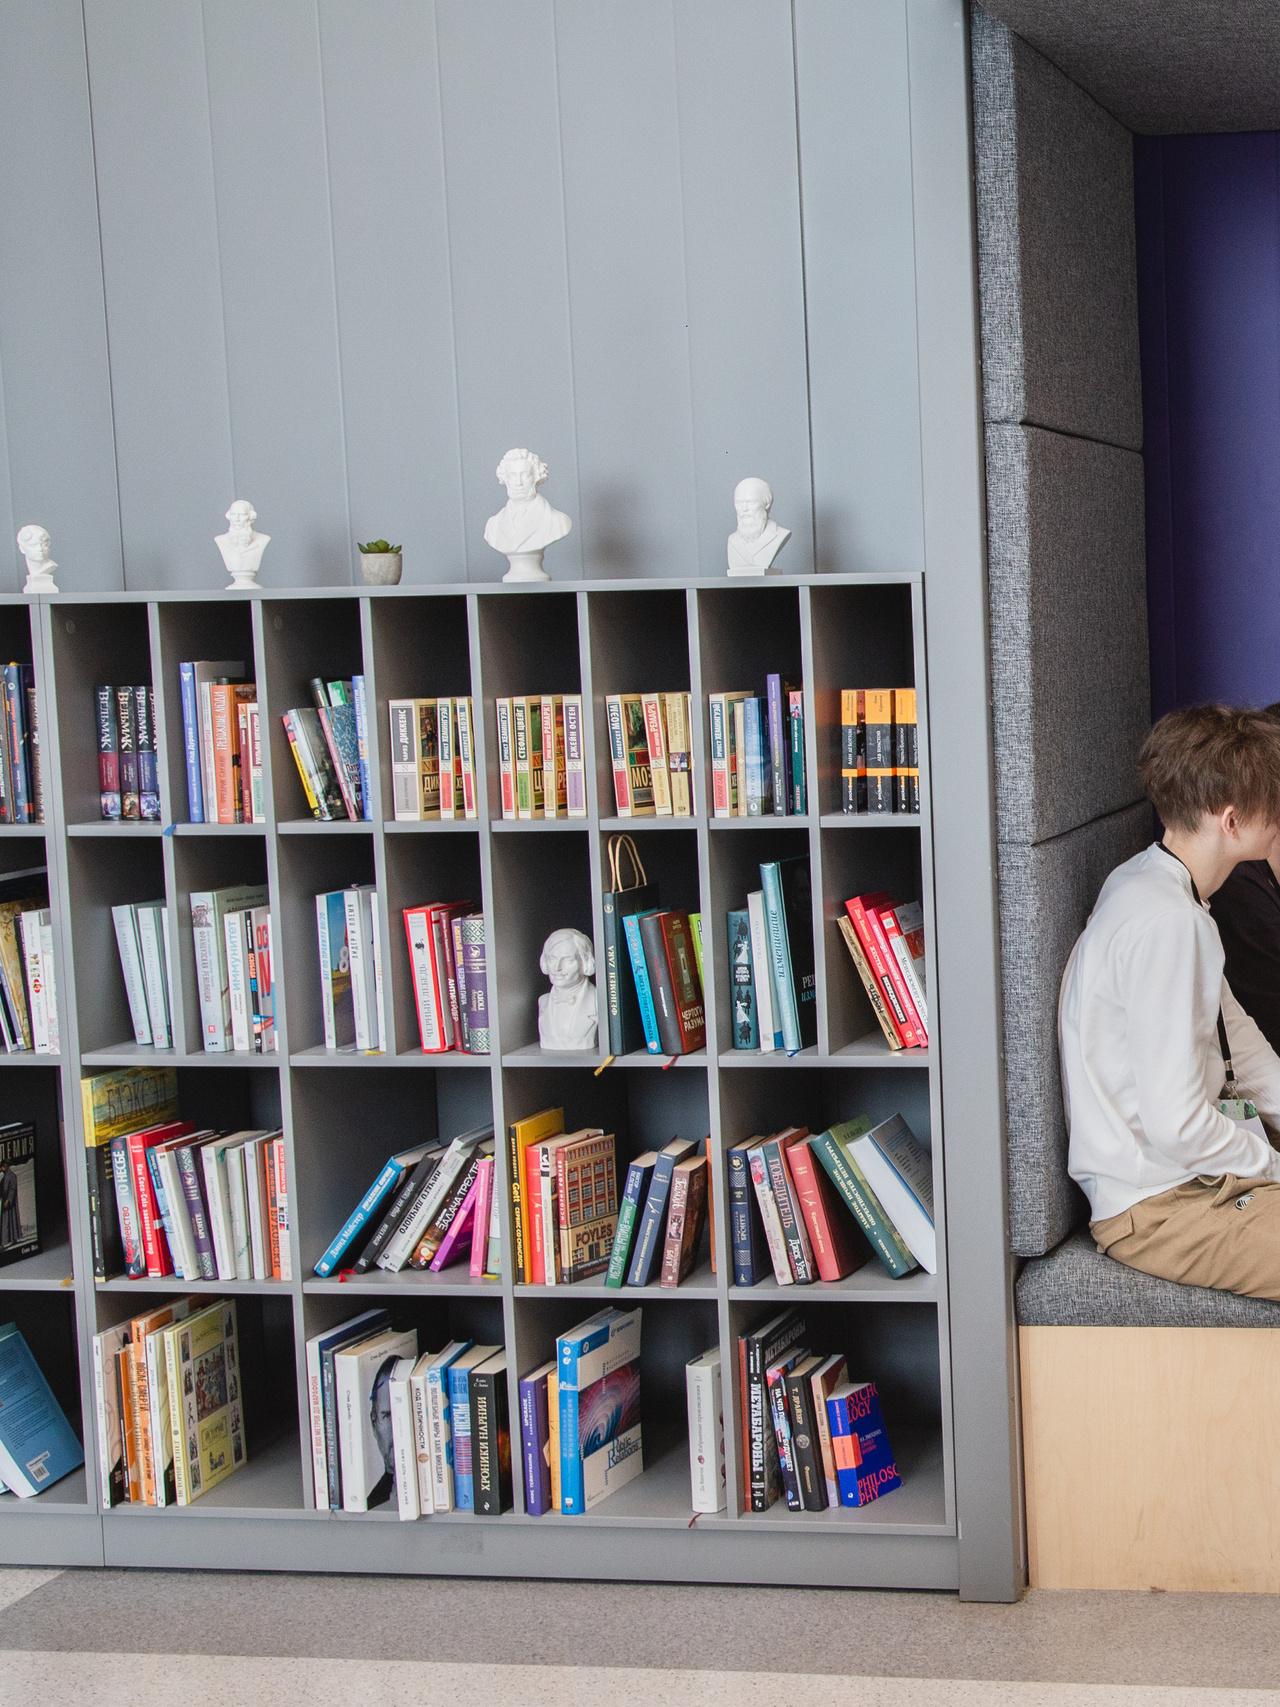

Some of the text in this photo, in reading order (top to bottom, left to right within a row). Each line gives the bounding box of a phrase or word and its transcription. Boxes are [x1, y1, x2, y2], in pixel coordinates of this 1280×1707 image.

[98, 691, 111, 748] ВЕДЬМАК
[117, 692, 132, 749] ВЕДЬМАК
[136, 691, 149, 745] ВЕДЬМАК
[214, 691, 228, 750] ТРЕВОЖНЫЕ ЛЮДИ
[399, 710, 409, 744] ДИККЕНС
[440, 707, 448, 742] ХЕМИНГУЭЙ
[499, 707, 508, 743] ХЕМИНГУЭЙ
[516, 708, 526, 758] СТЕФАН ЦВЕЙГ
[543, 707, 551, 733] РЕМАРК
[568, 707, 579, 758] ДЖЕЙН ОСТЕН
[609, 704, 619, 730] МОЭМ
[648, 703, 658, 732] РЕМАРК
[713, 704, 721, 739] ХЕМИНГУЭЙ
[359, 739, 368, 759] НЕТ
[347, 904, 356, 926] ПЛЕМЯ
[227, 920, 241, 991] иммунитет
[320, 931, 328, 958] ПРАВИЛУ
[350, 938, 359, 959] ЛИДЕР
[754, 921, 762, 961] TRANSCEND
[769, 909, 785, 978] изменившие
[869, 944, 887, 975] ЖЕСТКИЙ
[199, 931, 211, 1002] ФРАНЦУЗСКАЯ РЕВОЛЮЦИЯ
[607, 945, 617, 1016] ФЕНОМЕН ZARA
[419, 964, 434, 1038] ЧЕРНЫЙ ЛЕБЕДЬ
[448, 978, 458, 1021] АНТИРЕЙДЕР
[866, 983, 886, 1015] нефть
[138, 1176, 147, 1207] Coca-Cola
[436, 1172, 477, 1232] ЗАДАЧА ТРЕХ
[512, 1182, 521, 1203] Gett
[823, 1139, 878, 1227] ОКРЕСТНОСТЕЙ ПЕТЕРБУРГА
[832, 1167, 871, 1231] ЗАБЫТОЕ ПРОШЛОЕ
[397, 1171, 444, 1235] НИЧЕГО ЛИЧНОГО
[769, 1158, 807, 1280] ПОБЕДИТЕЛЬ Джек Уэлч
[122, 1206, 134, 1263] Королевство
[270, 1209, 281, 1268] БУКОВСКИ
[327, 1211, 365, 1258] Дэвид Майстер
[516, 1238, 524, 1269] СМЫСЛОМ
[576, 1223, 613, 1247] FOYLES
[615, 1223, 631, 1246] ВИДЫ
[608, 1254, 624, 1280] ФУДЗИ
[311, 1375, 320, 1405] МАРАФОНА
[313, 1415, 322, 1435] МЕТРОВ
[416, 1402, 425, 1449] ПУБЛИЧНОСТИ
[453, 1403, 471, 1437] PICCOLA
[751, 1383, 763, 1472] МЕТАБАРОНЫ
[847, 1399, 871, 1424] LOGY
[431, 1387, 443, 1484] ВОЛШЕБНЫЕ МИРЫ ХАЯО МИЯДЗАКИ
[477, 1396, 491, 1491] ХРОНИКИ НАРНИИ
[611, 1436, 632, 1457] Public
[173, 1439, 184, 1497] ИСТОРИЯ ДЕНЕГ
[607, 1442, 639, 1470] Relations
[859, 1486, 878, 1505] PHY
